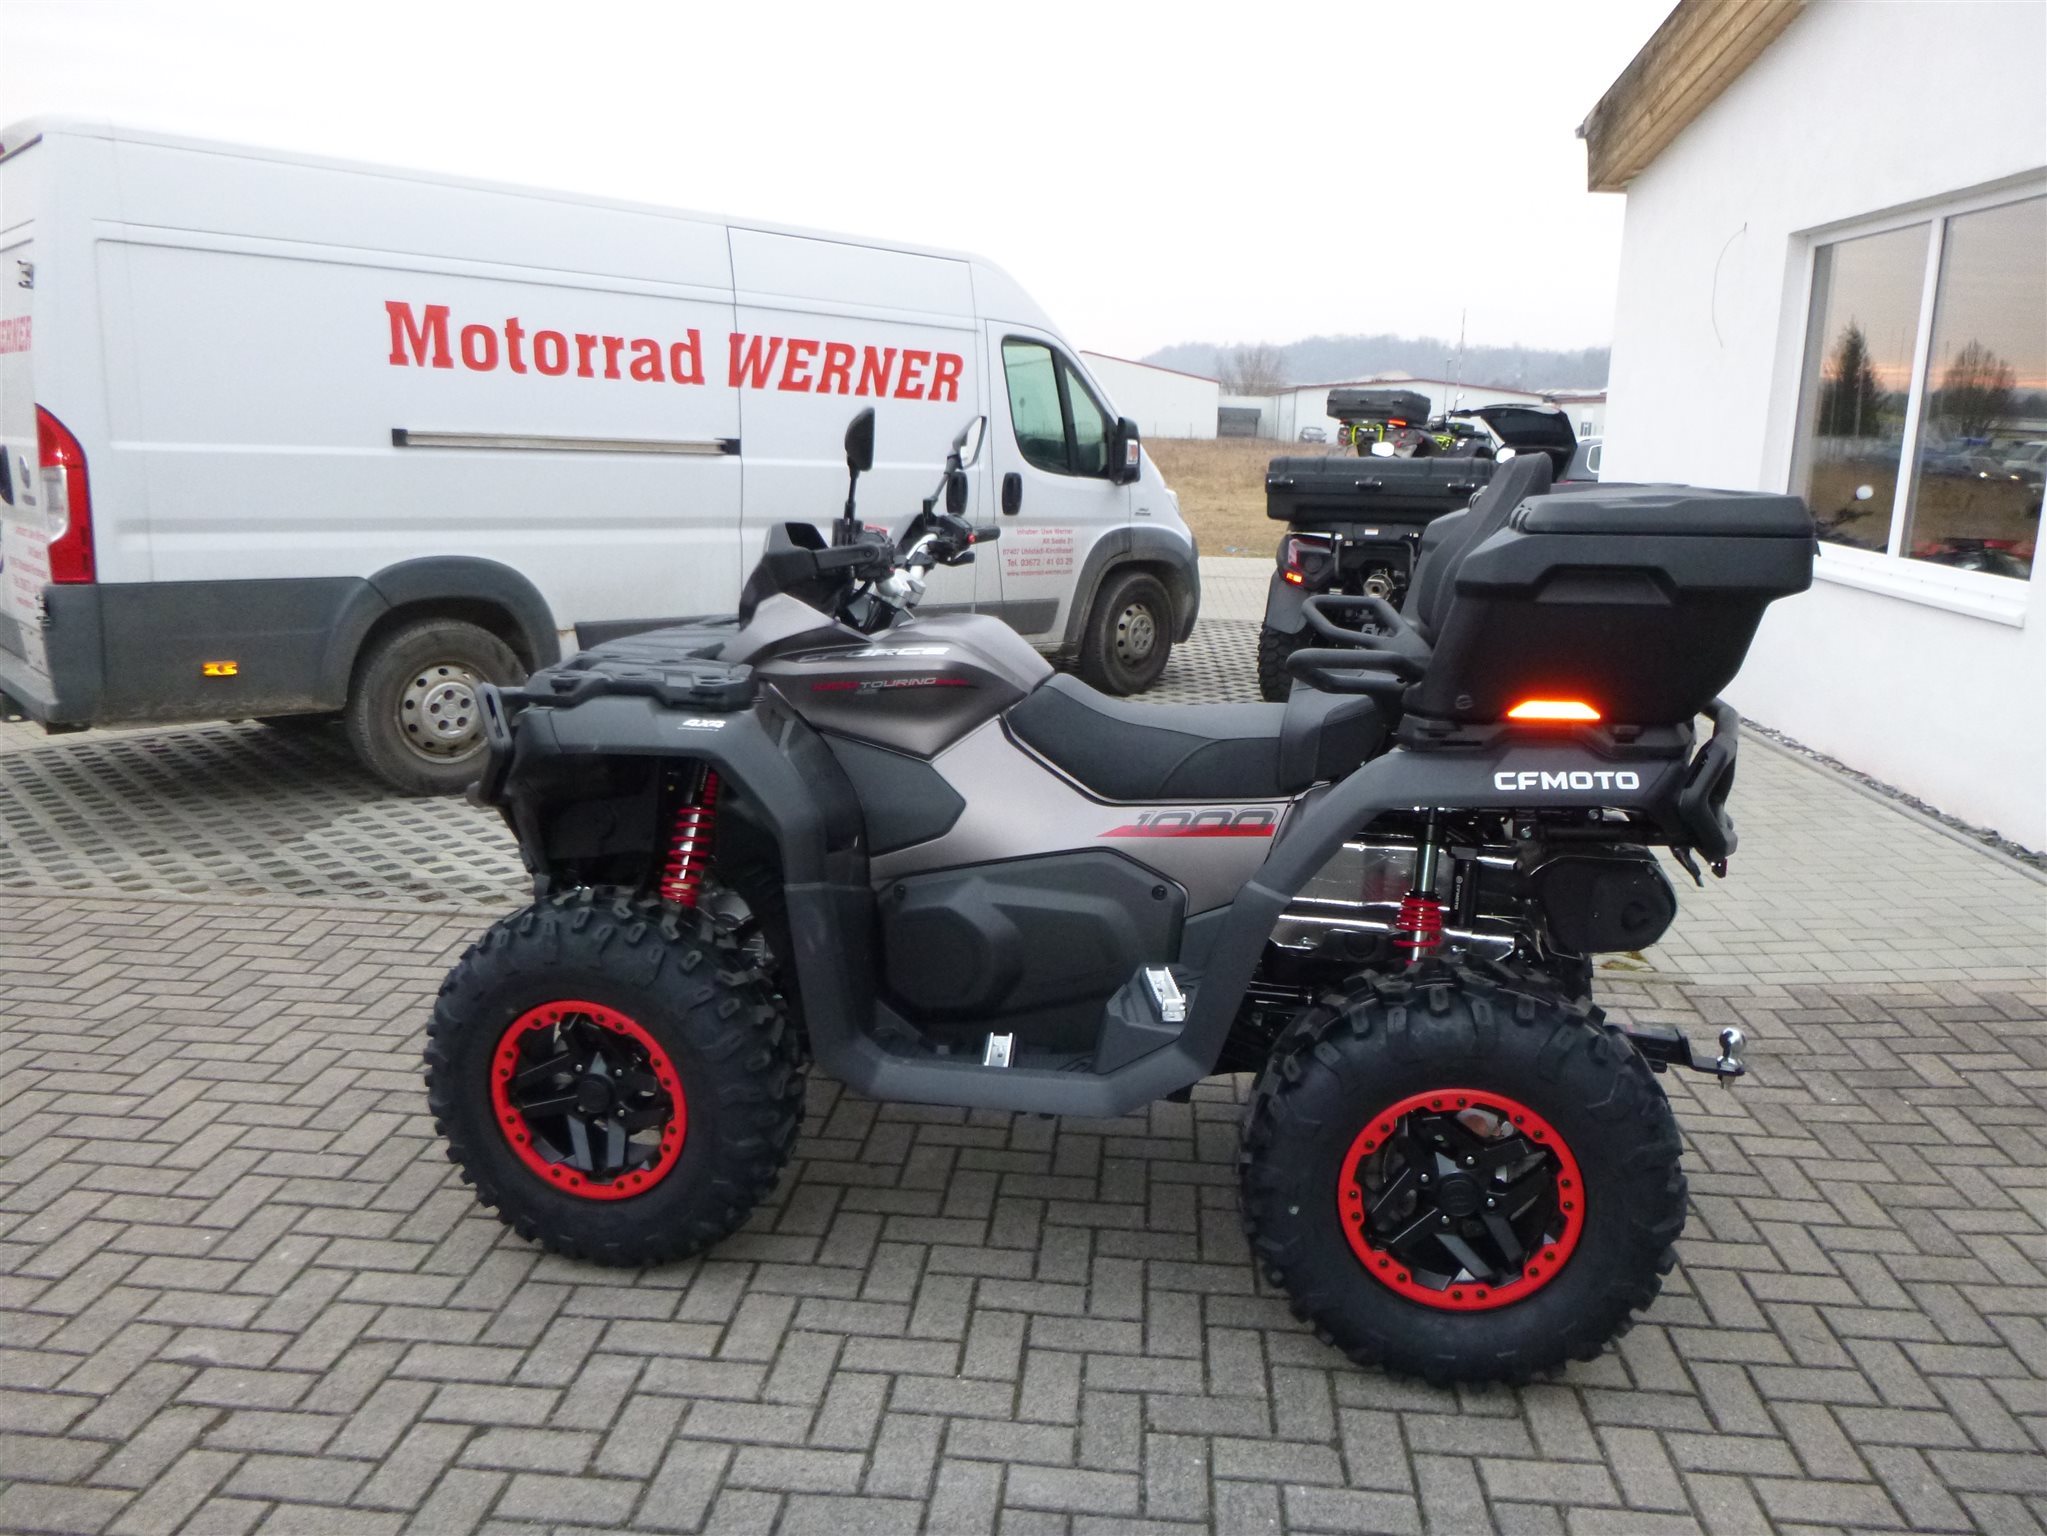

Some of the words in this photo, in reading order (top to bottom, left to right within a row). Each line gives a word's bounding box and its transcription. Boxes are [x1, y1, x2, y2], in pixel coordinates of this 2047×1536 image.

[385, 300, 705, 386] Motorrad
[727, 332, 964, 403] WERNER
[859, 677, 937, 689] TOURING
[1494, 771, 1640, 791] CFMOTO
[1136, 807, 1278, 834] 1000
